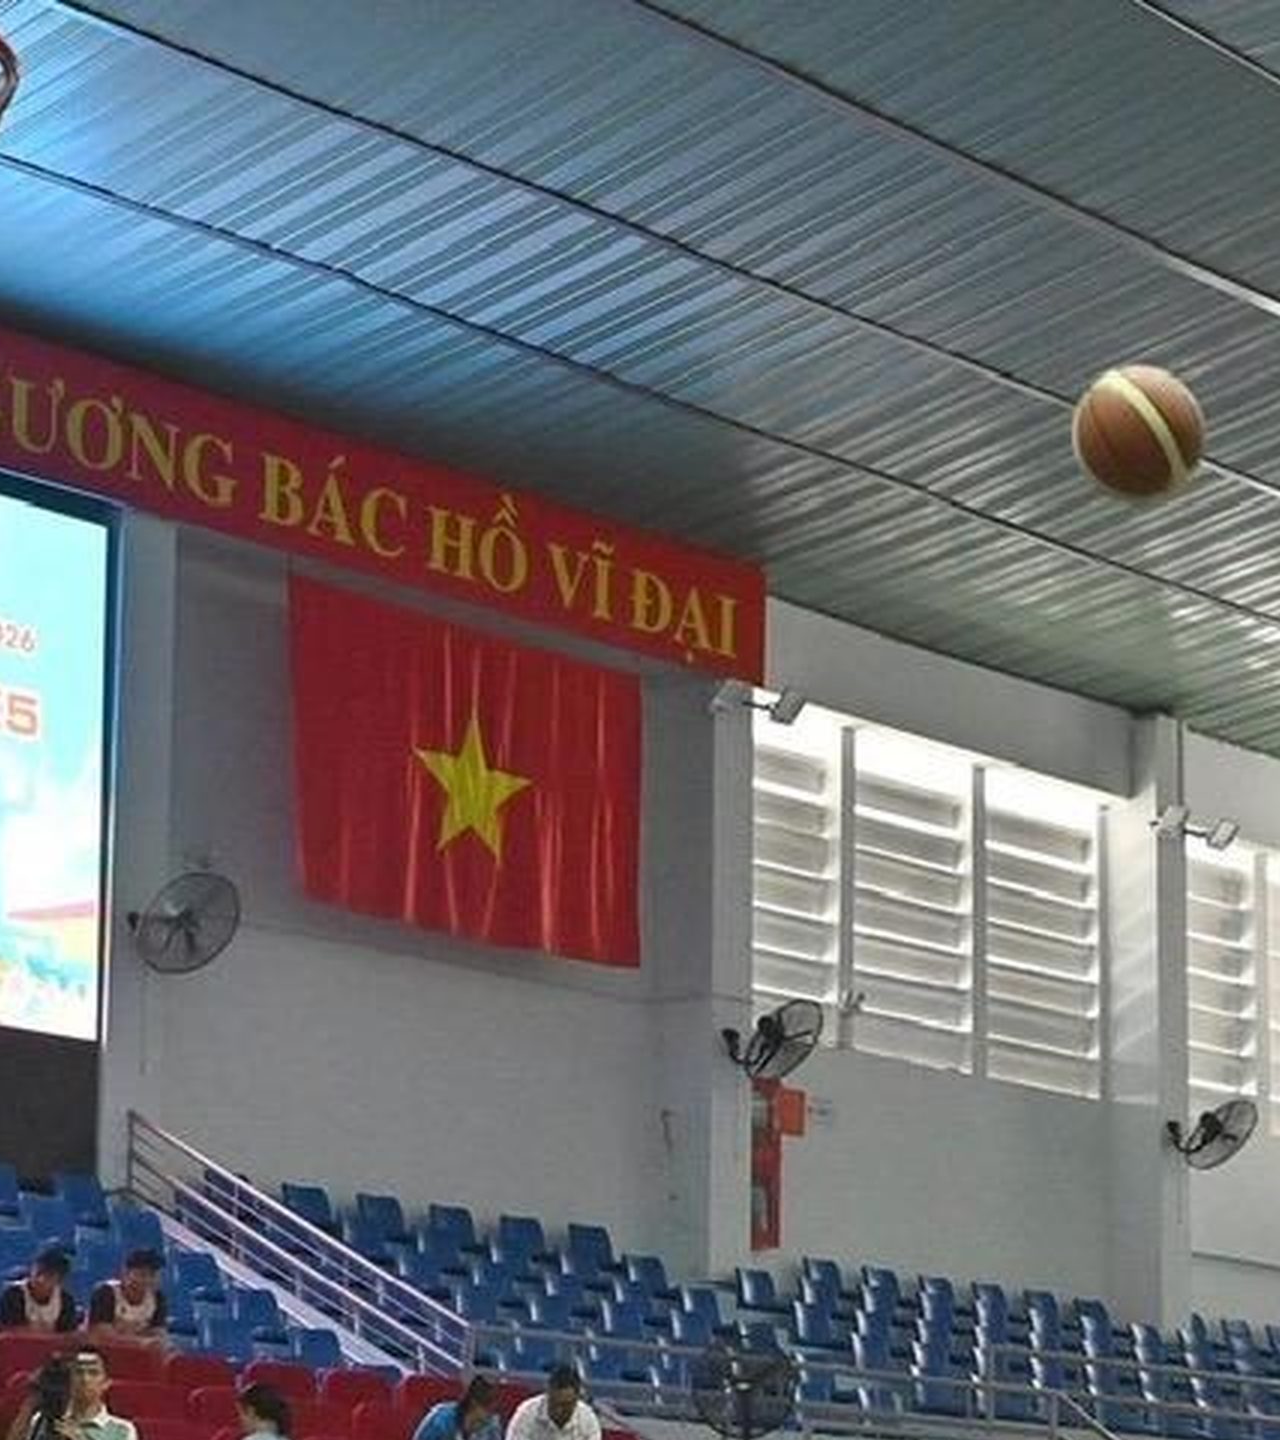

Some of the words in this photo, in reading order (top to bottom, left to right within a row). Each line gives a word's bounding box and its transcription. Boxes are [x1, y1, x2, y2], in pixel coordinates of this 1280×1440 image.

[259, 455, 408, 557] BÁC
[429, 494, 528, 593] HỒ
[548, 539, 615, 620] VĨ
[629, 567, 738, 663] ĐẠI
